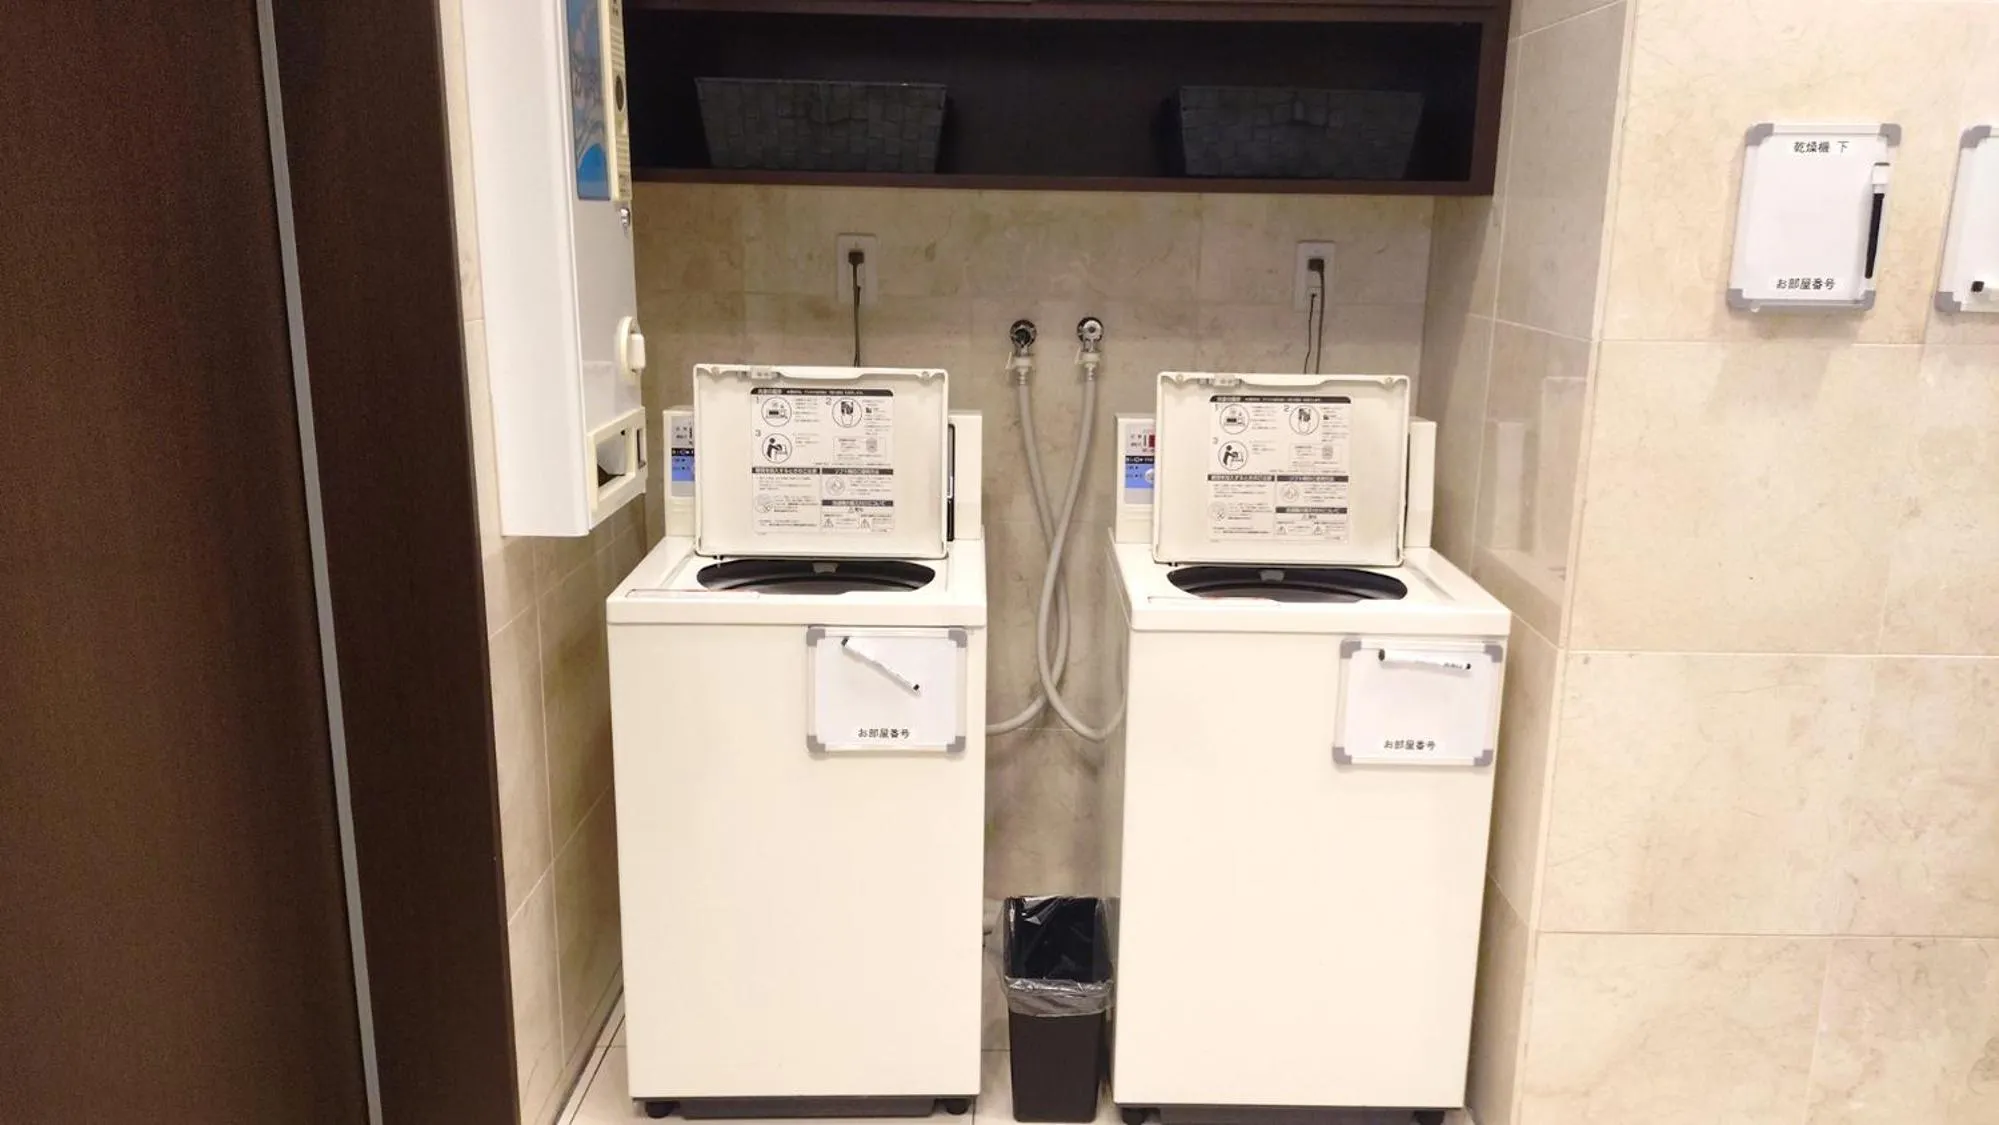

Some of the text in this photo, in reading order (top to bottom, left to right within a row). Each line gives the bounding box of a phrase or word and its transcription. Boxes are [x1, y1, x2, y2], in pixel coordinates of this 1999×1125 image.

[1793, 140, 1850, 153] 乾燥機 下
[1776, 278, 1836, 290] お部屋番号
[857, 727, 911, 740] お部屋番号
[1383, 739, 1436, 751] お部屋番号
